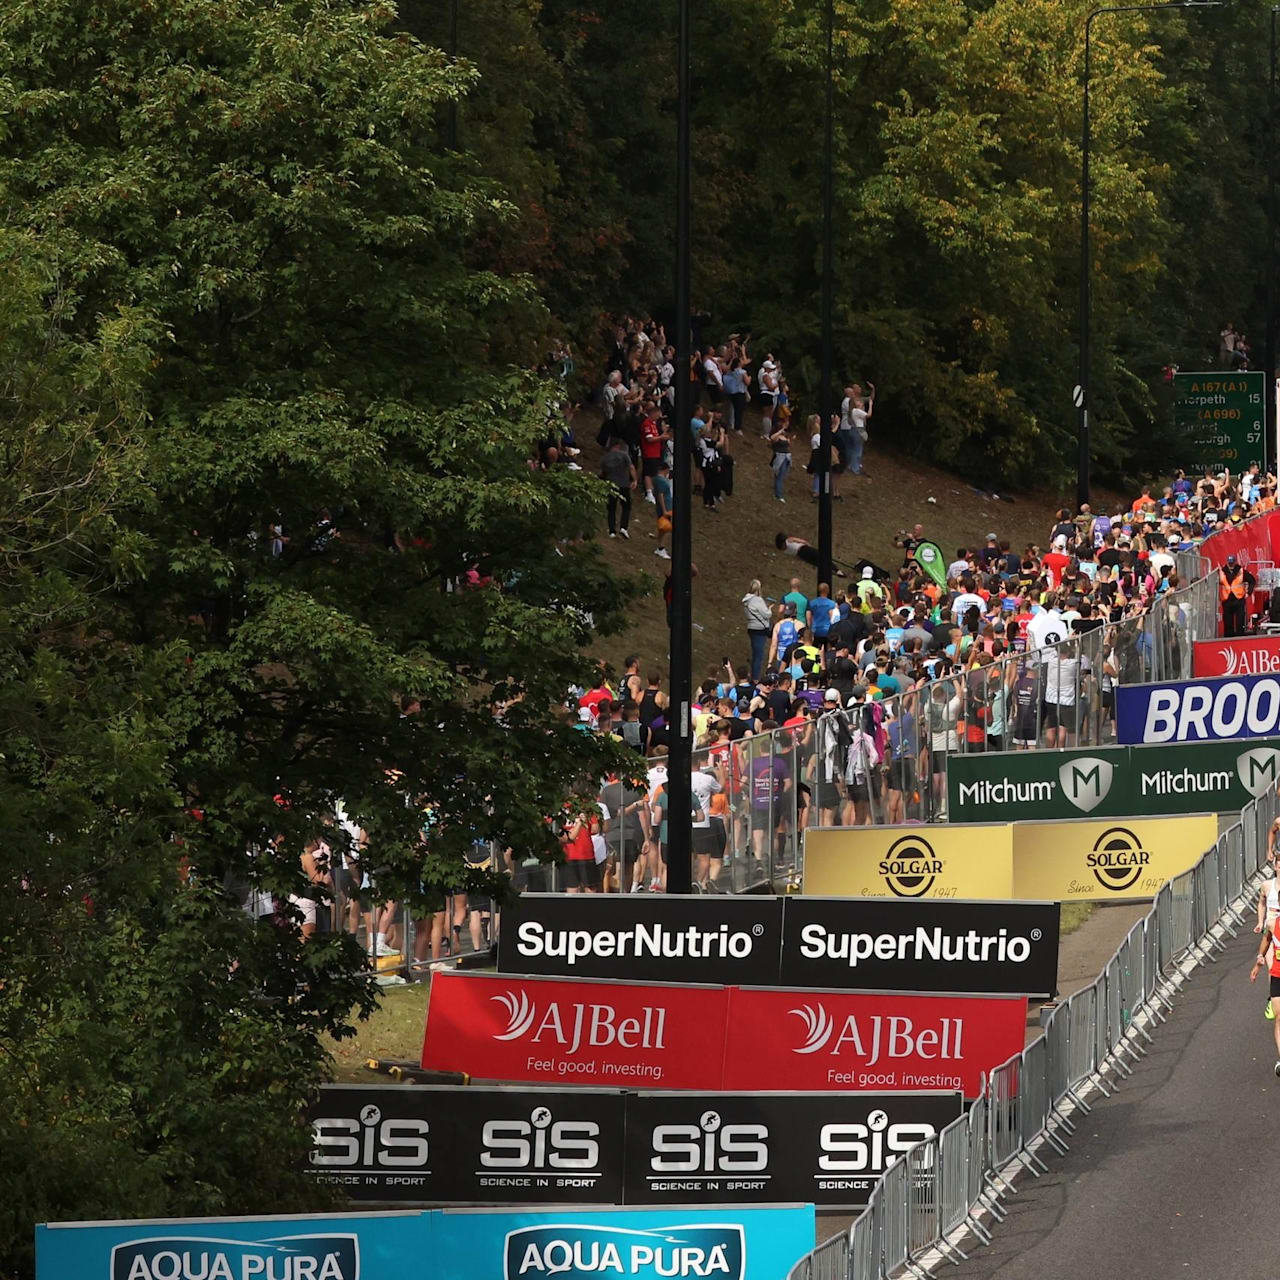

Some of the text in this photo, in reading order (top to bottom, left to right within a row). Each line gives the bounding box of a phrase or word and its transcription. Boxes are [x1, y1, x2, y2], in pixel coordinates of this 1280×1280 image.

[1248, 394, 1260, 403] 15
[1253, 421, 1261, 430] 6
[1247, 433, 1261, 443] 57
[960, 777, 1051, 805] Mitchum
[1142, 768, 1229, 796] Mitchum
[878, 858, 943, 877] SOLGAR
[1087, 851, 1150, 868] SOLGAR
[933, 887, 957, 897] 1947
[1140, 877, 1165, 890] 1947
[531, 1002, 665, 1055] AJBell
[831, 1015, 963, 1066] AJBell
[527, 1057, 666, 1079] Feel good, investing.
[827, 1069, 964, 1089] Feel good, investing.
[309, 1104, 430, 1166] SiS
[480, 1106, 600, 1169] SiS
[650, 1110, 769, 1172] SiS
[365, 1176, 426, 1186] IN SPORT
[480, 1177, 596, 1187] SCIENCE IN SPORT
[651, 1181, 766, 1191] SCIENCE IN SPORT
[818, 1181, 869, 1190] SCIENCE
[126, 1250, 345, 1280] AQUA PURA
[518, 1239, 730, 1277] AQUA PURA
